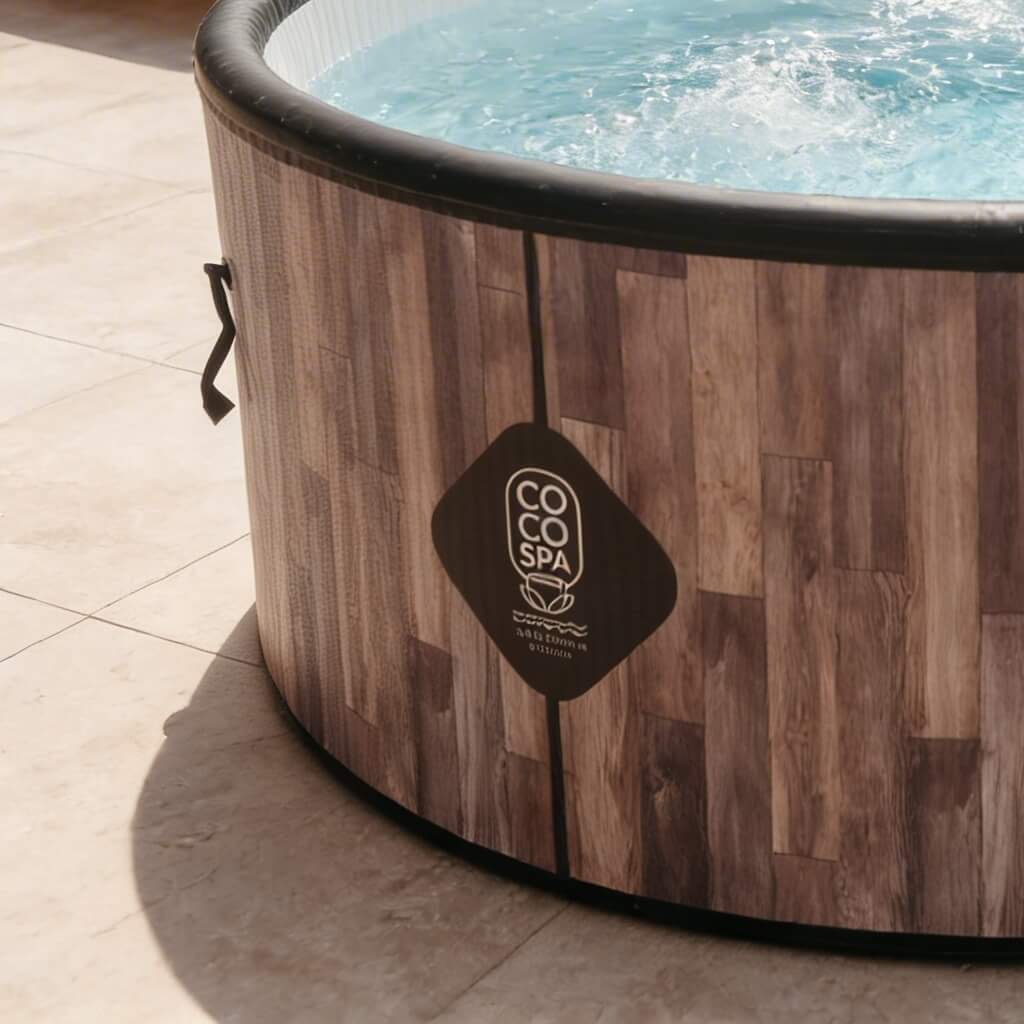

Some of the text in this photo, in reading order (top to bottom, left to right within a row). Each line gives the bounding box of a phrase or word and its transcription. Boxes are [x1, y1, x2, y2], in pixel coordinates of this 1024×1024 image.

[516, 480, 568, 516] CO
[518, 512, 569, 548] CO
[519, 541, 572, 575] SPA
